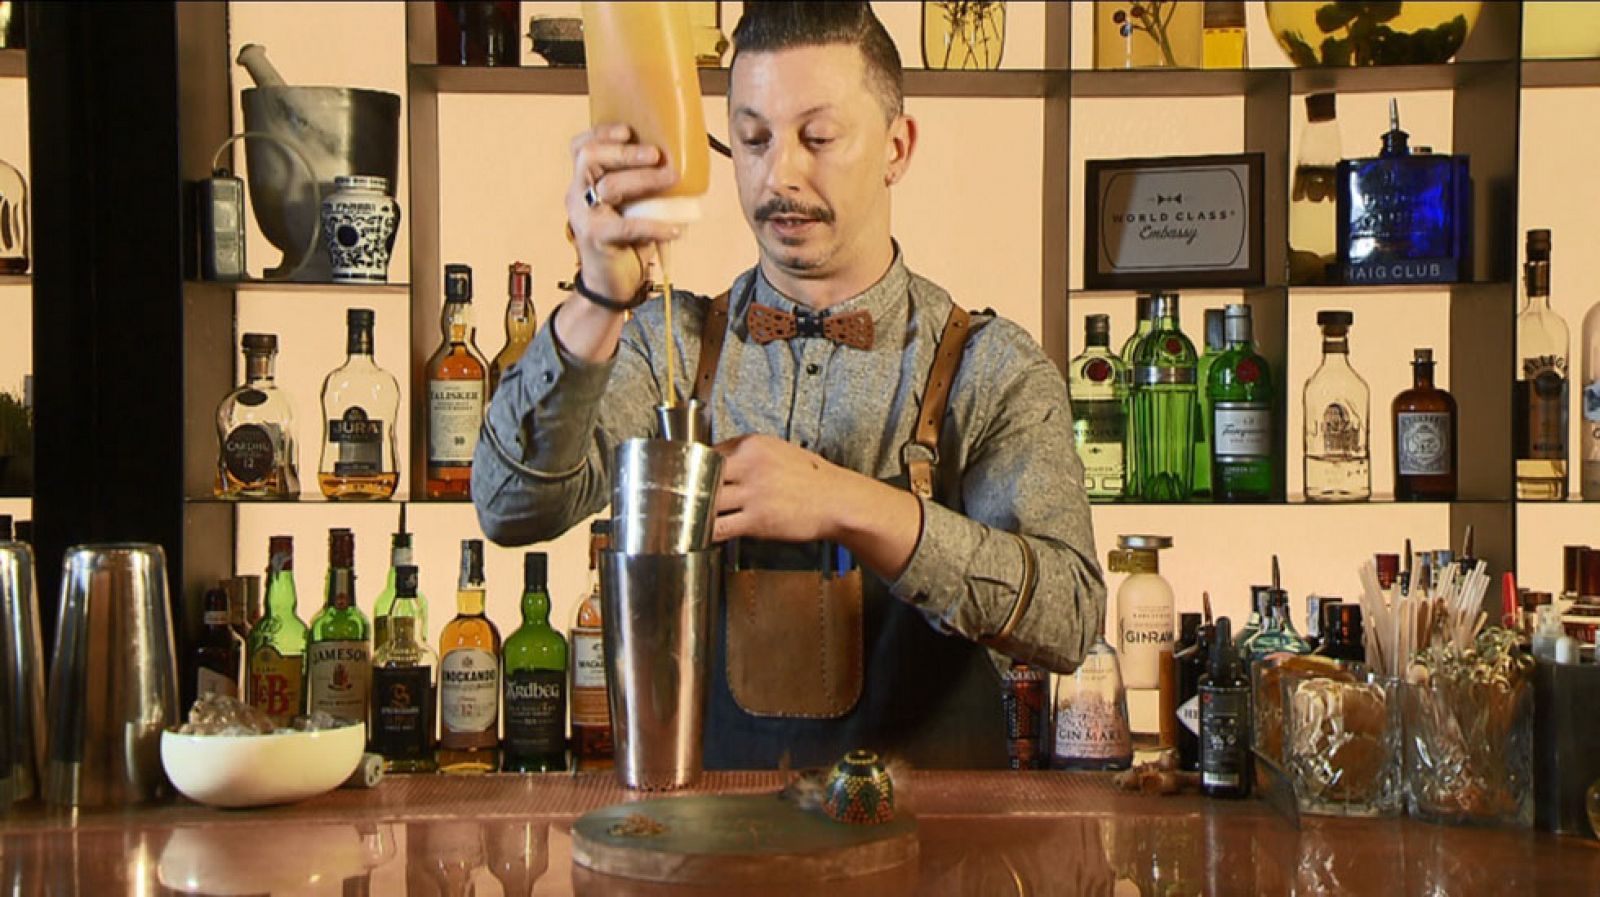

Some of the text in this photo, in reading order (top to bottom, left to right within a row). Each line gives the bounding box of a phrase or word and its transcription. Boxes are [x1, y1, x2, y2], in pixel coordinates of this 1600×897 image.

[1112, 211, 1169, 224] WORLD
[1139, 223, 1198, 246] Embassy
[1344, 263, 1441, 280] HAIG CLUB
[333, 420, 380, 434] JURA
[460, 703, 473, 717] 12
